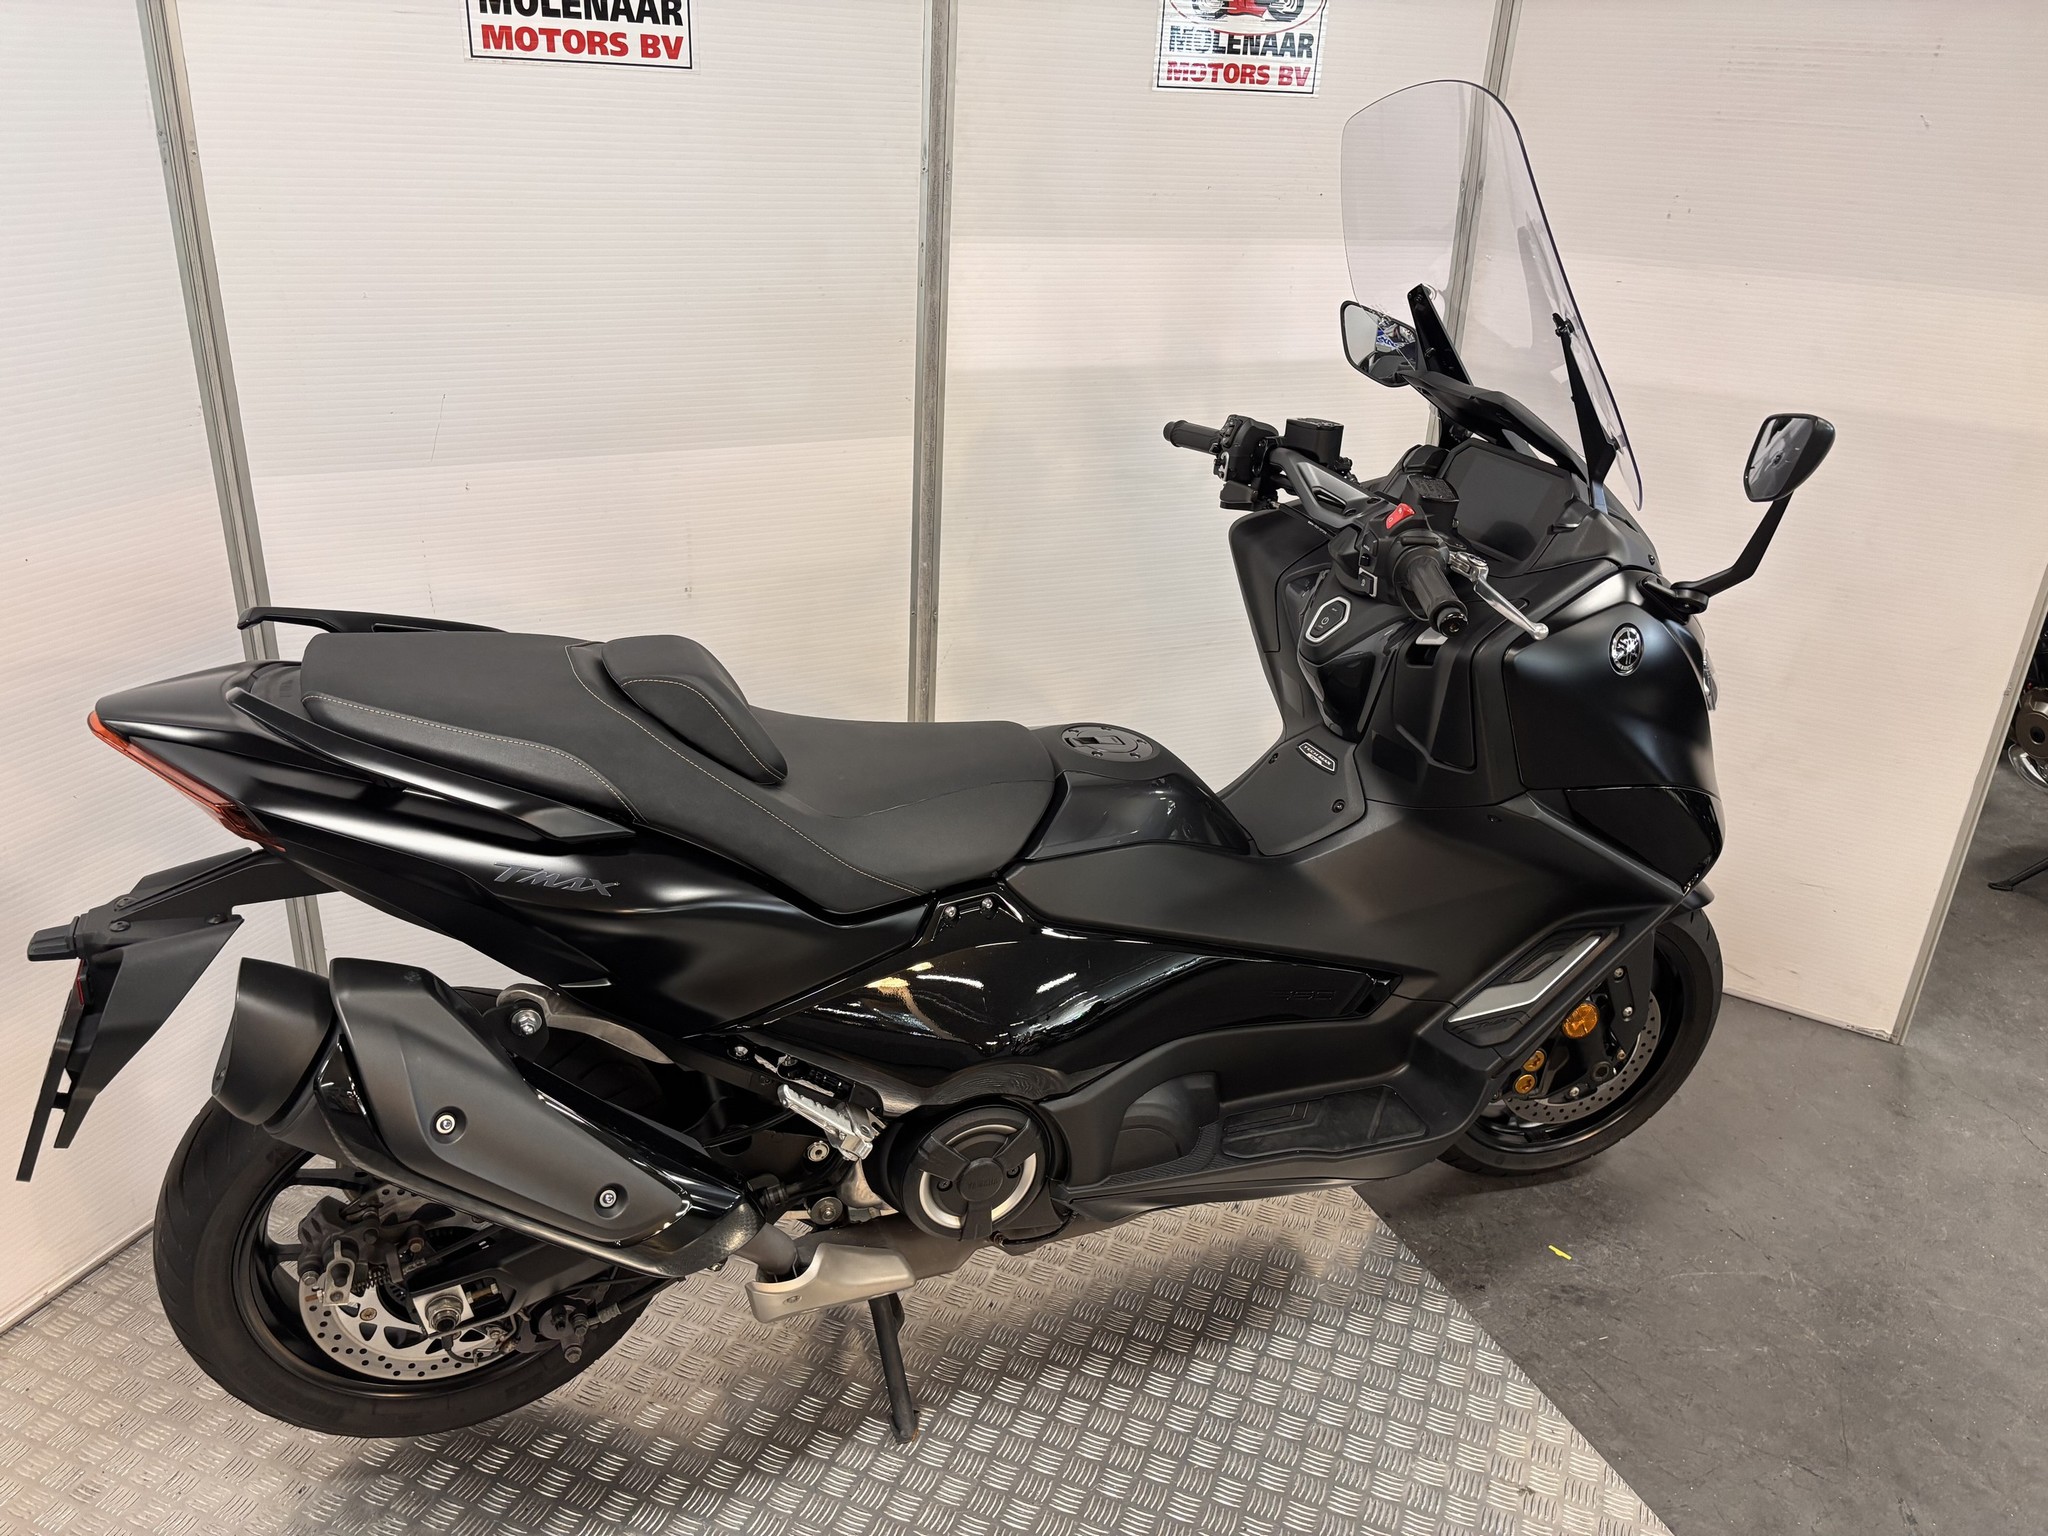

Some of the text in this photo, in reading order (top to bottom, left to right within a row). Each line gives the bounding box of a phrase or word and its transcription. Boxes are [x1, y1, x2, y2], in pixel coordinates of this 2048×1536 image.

[481, 24, 684, 60] MOTORS BV
[1169, 25, 1315, 59] MOLENAAR
[1166, 60, 1311, 87] MOTORS BV
[493, 861, 621, 897] TMAX
